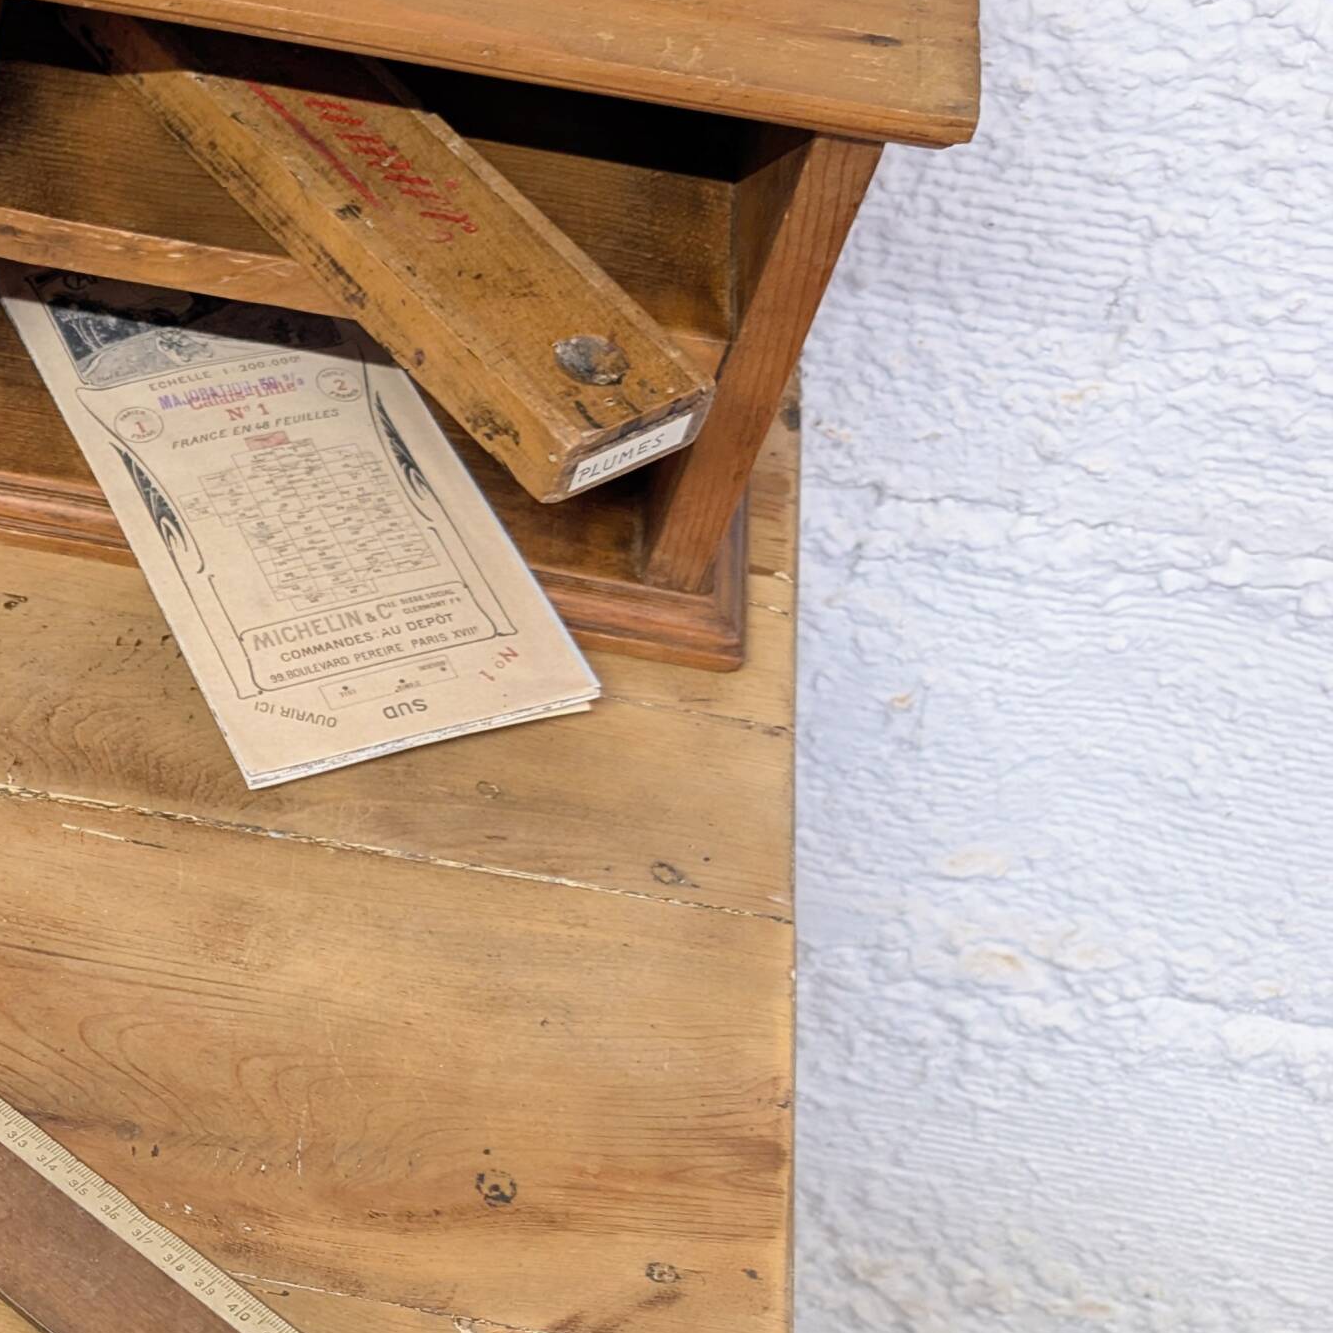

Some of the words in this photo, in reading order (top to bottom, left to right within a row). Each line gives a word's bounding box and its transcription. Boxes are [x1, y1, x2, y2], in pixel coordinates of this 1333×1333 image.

[333, 378, 348, 392] 2
[135, 420, 148, 434] 1
[172, 430, 229, 450] FRANCE
[233, 424, 255, 438] EN
[275, 408, 341, 429] FEUILLES
[577, 433, 665, 482] PLUMES
[253, 610, 363, 651] MICHELIN
[381, 626, 401, 639] AU
[287, 656, 350, 678] BOULEVARD
[354, 643, 404, 662] PEREIRE
[411, 633, 448, 649] PARIS
[254, 701, 275, 714] ICI
[280, 706, 337, 728] OUVRIR
[383, 698, 428, 720] SUD
